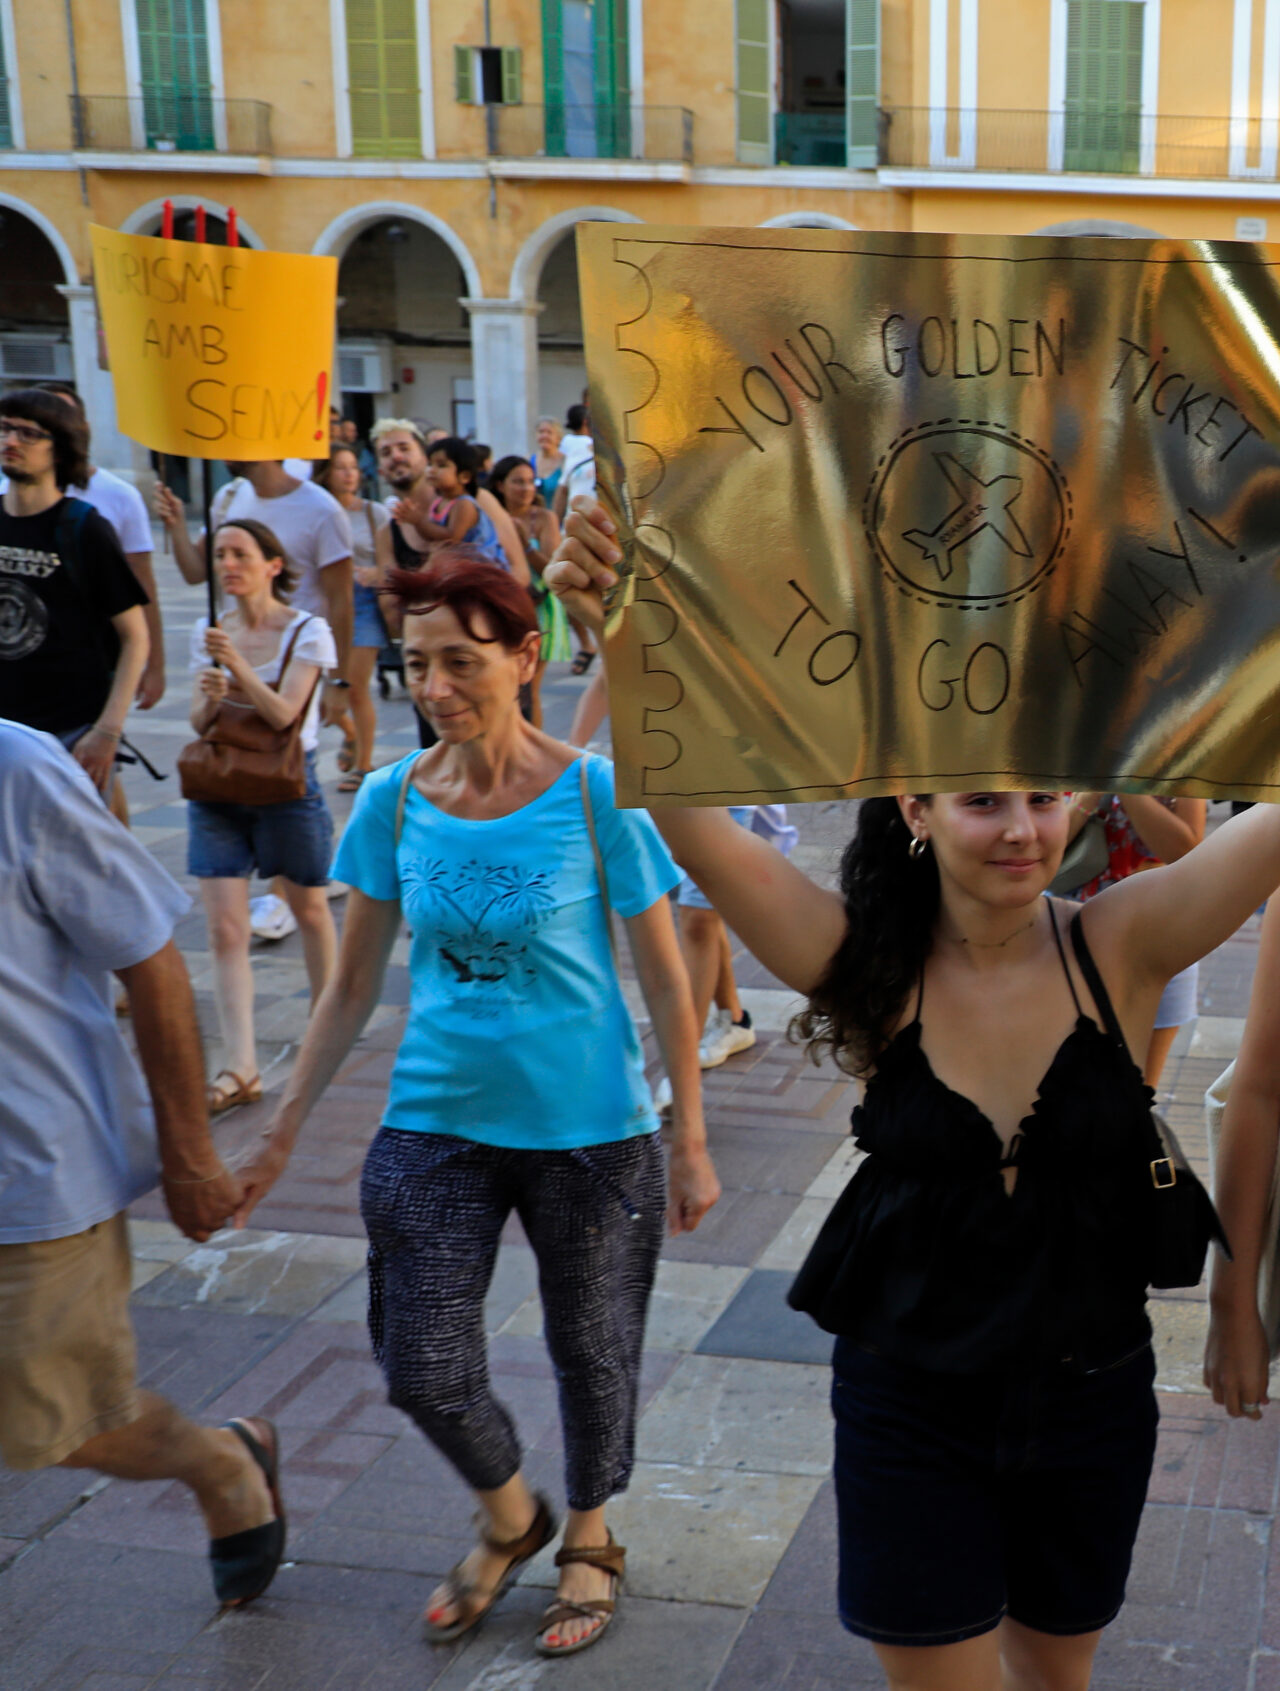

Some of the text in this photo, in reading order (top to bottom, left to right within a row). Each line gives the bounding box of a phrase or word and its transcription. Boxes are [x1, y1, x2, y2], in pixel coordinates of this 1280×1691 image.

[142, 317, 229, 367] AMB
[697, 313, 1266, 463] YOUR GOLDEN TICKET
[182, 369, 328, 442] SENY!
[773, 506, 1248, 716] TO GO AWAY!
